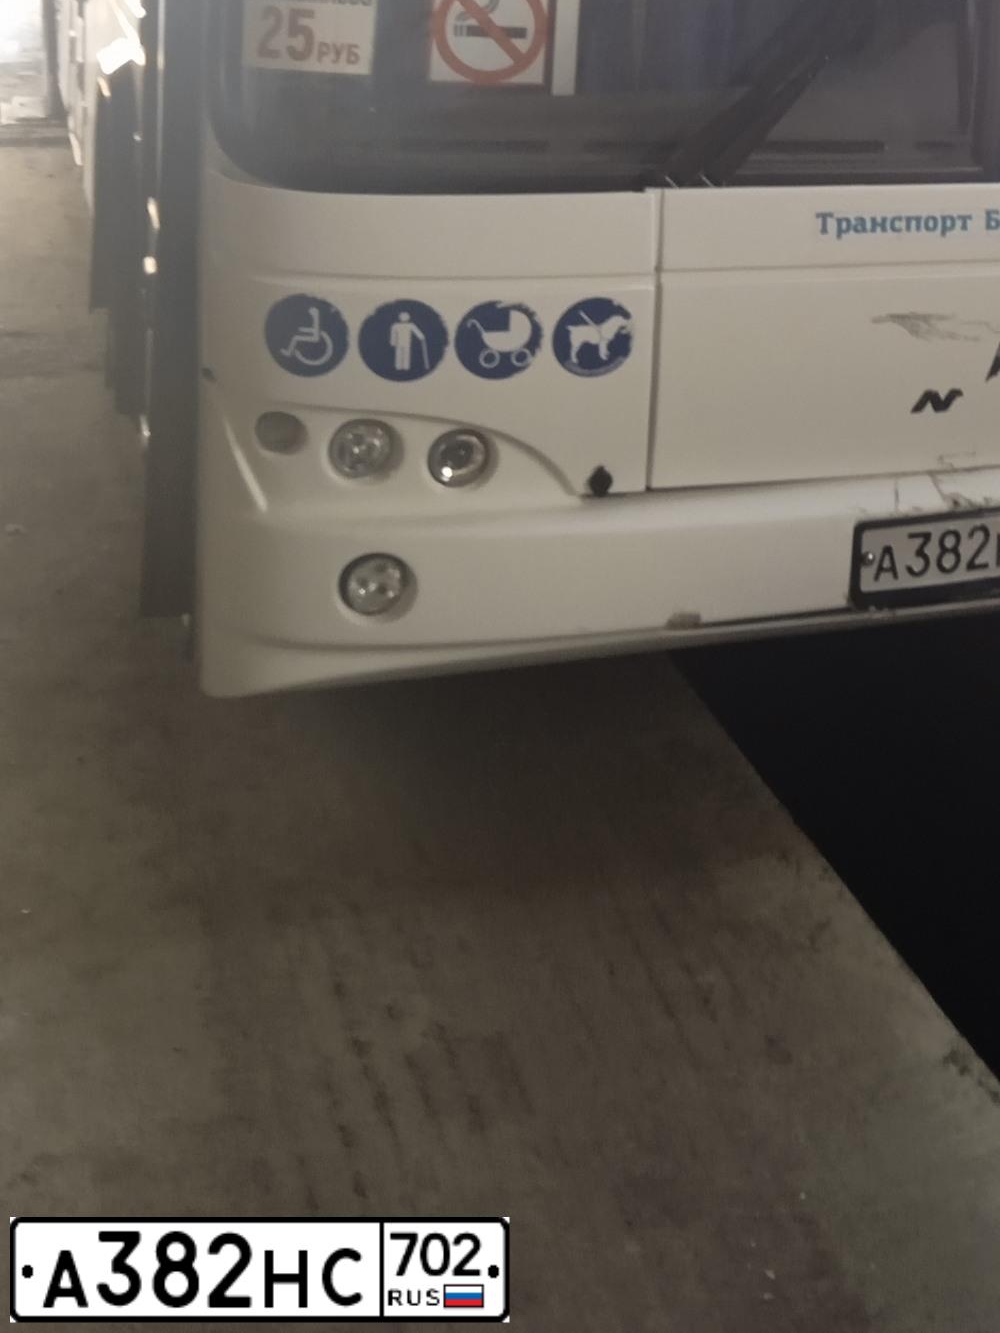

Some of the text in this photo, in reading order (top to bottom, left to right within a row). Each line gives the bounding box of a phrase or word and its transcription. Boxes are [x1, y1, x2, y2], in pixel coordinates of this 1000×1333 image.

[257, 5, 361, 65] 25 РУБ
[815, 212, 973, 240] Транспорт
